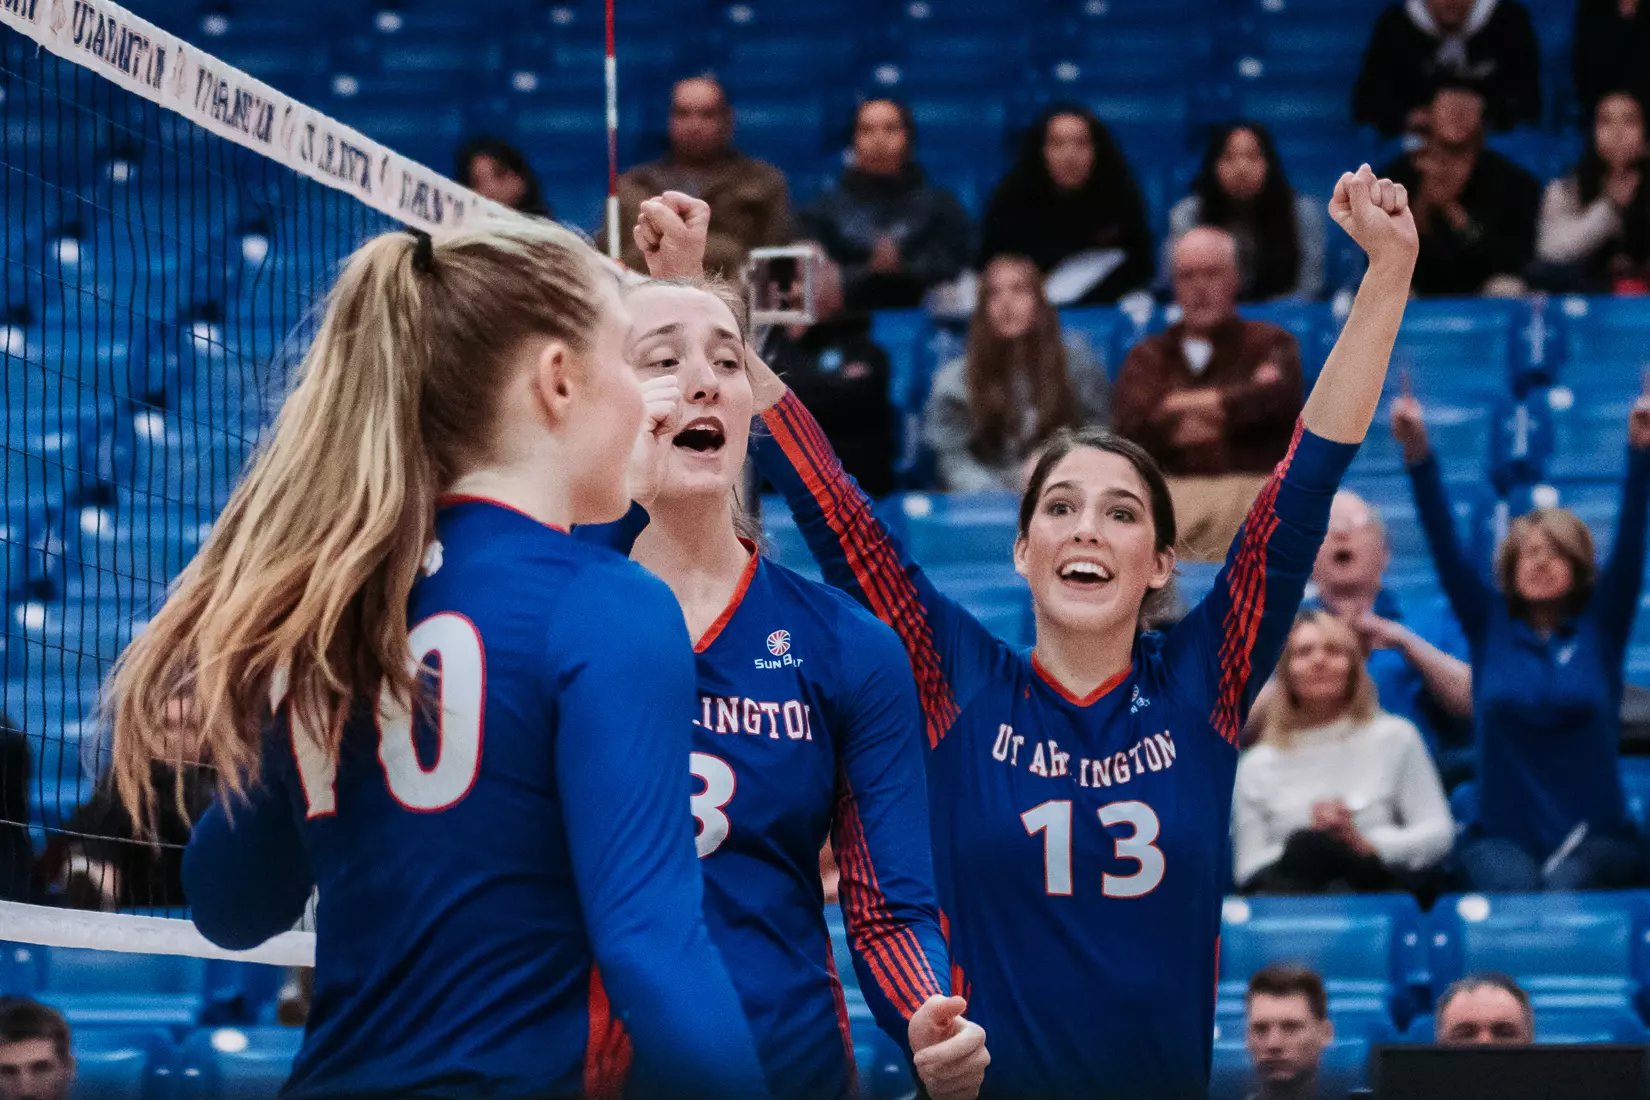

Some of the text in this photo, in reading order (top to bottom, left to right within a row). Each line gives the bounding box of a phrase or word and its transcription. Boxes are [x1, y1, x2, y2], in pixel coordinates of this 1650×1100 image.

[782, 653, 804, 668] BLT
[991, 723, 1177, 788] UT ARINGTON
[1019, 799, 1167, 899] 13
